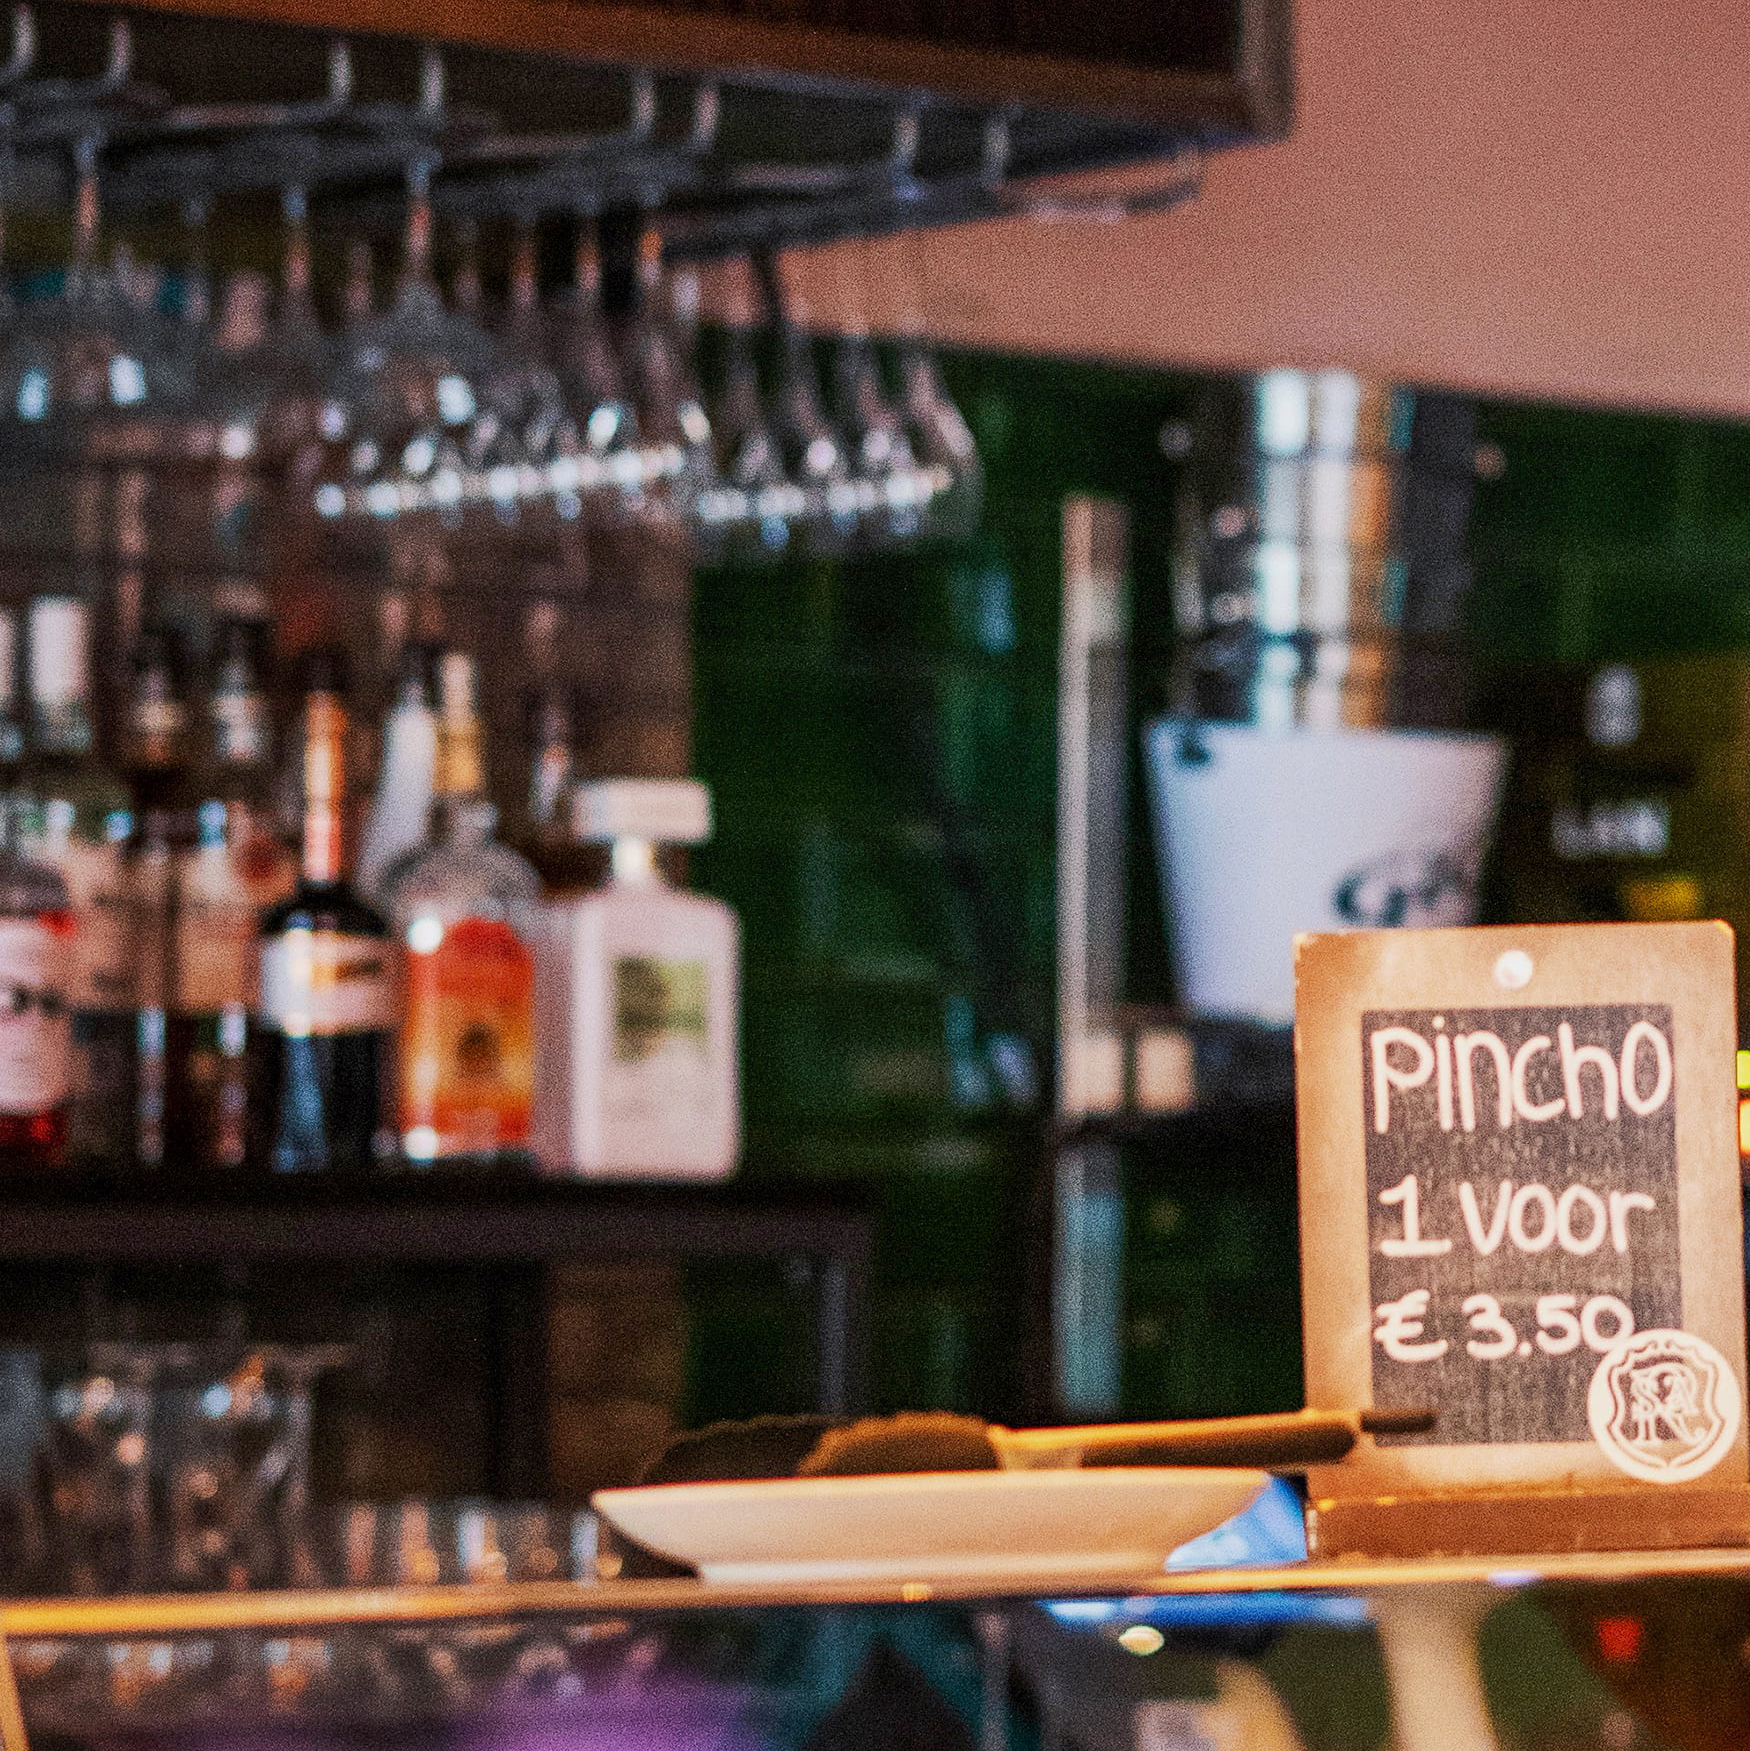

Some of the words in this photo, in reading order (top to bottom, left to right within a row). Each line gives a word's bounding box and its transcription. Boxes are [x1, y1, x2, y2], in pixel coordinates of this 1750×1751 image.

[1376, 1174, 1453, 1258] 1
[1374, 1287, 1450, 1362] €
[1464, 1293, 1638, 1360] 3.50
